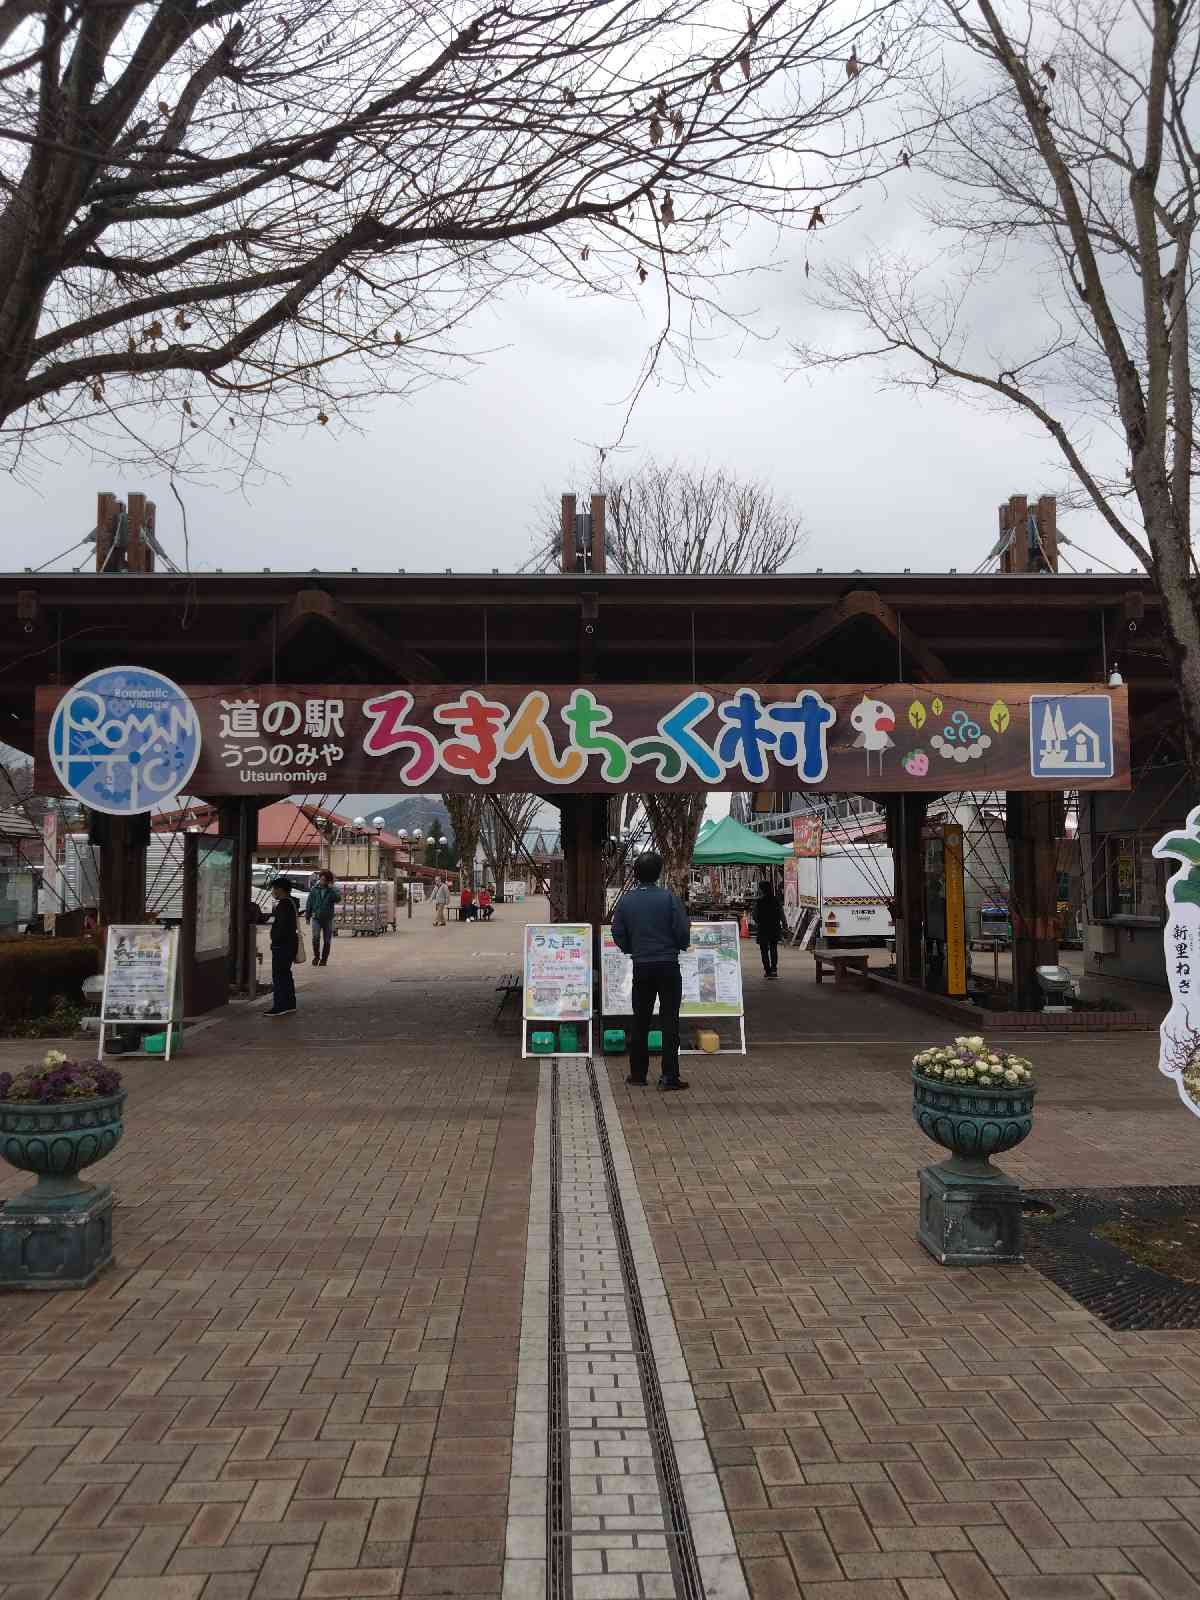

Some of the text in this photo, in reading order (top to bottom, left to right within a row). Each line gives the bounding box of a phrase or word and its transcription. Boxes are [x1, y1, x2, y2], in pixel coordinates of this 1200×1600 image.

[113, 687, 169, 699] Romantic
[129, 700, 169, 711] Village
[219, 699, 345, 738] 道の駅
[362, 688, 837, 787] ろまんちっく村
[220, 743, 345, 768] うつのみや
[239, 769, 328, 784] Utsunomiya
